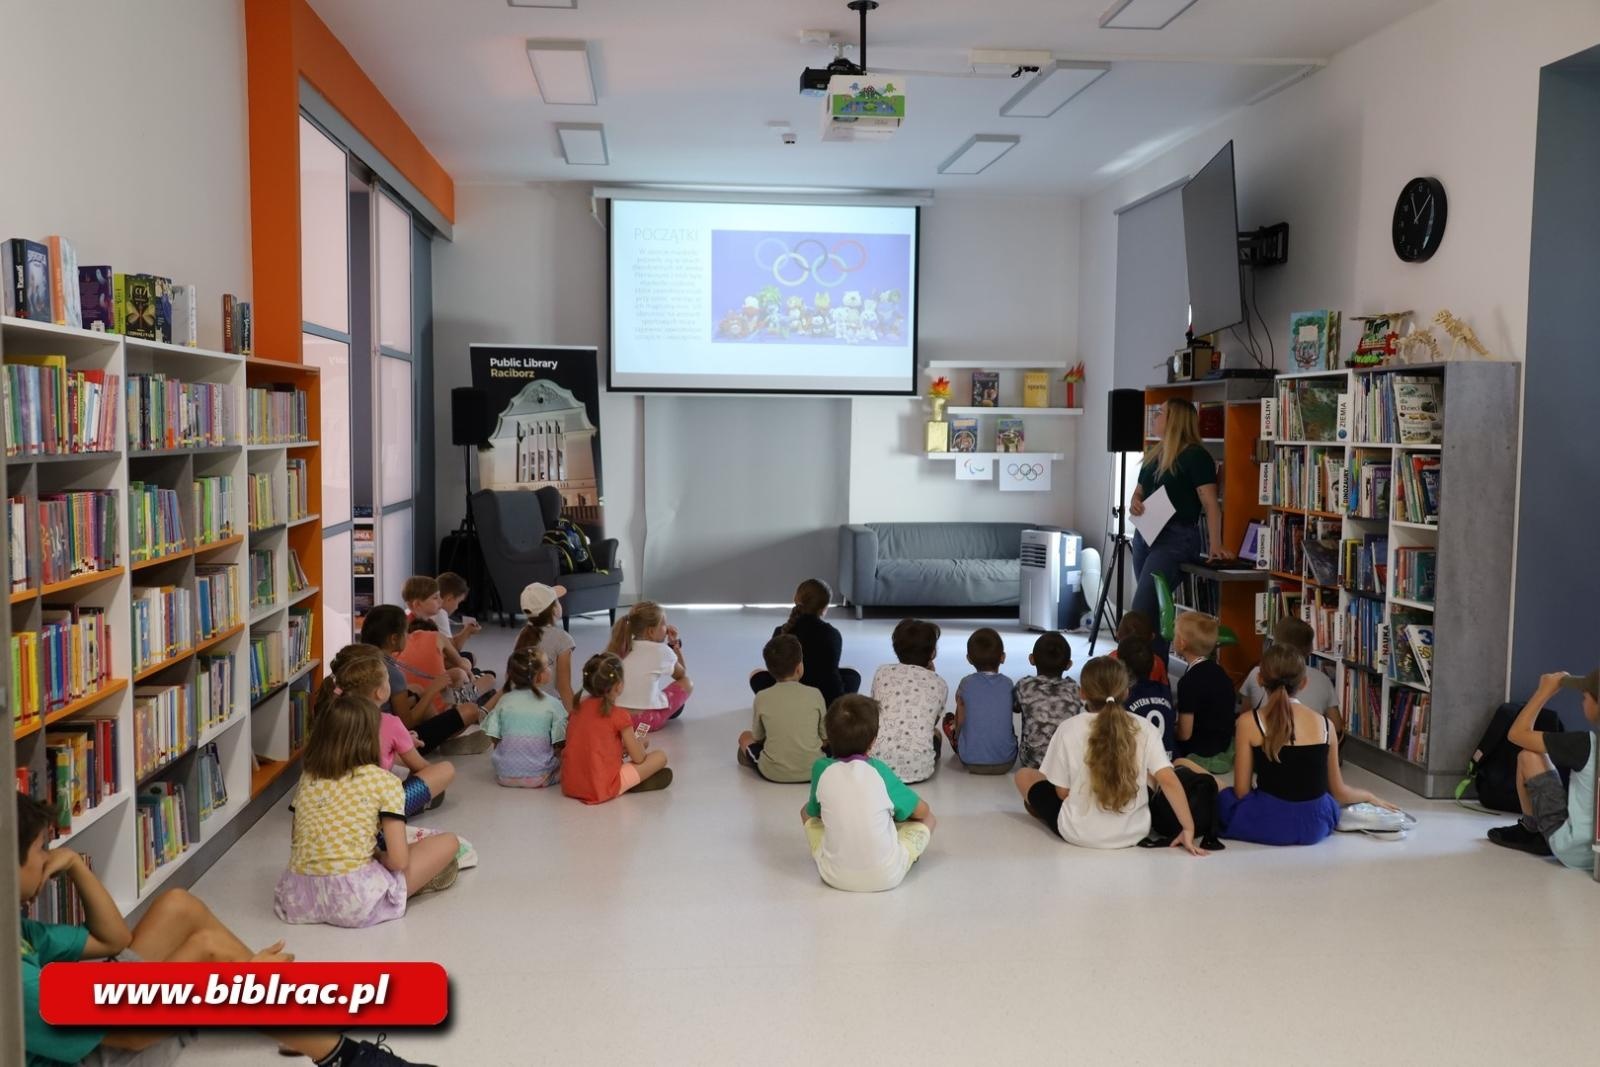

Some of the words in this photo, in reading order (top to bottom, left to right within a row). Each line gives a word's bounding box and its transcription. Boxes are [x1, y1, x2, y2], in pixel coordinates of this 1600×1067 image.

[634, 227, 698, 244] POCZĄTKI
[490, 357, 522, 368] Public
[523, 358, 558, 370] Library
[490, 368, 535, 378] Raciborz
[1383, 625, 1391, 656] NAUKA
[1129, 697, 1151, 712] BAYERN
